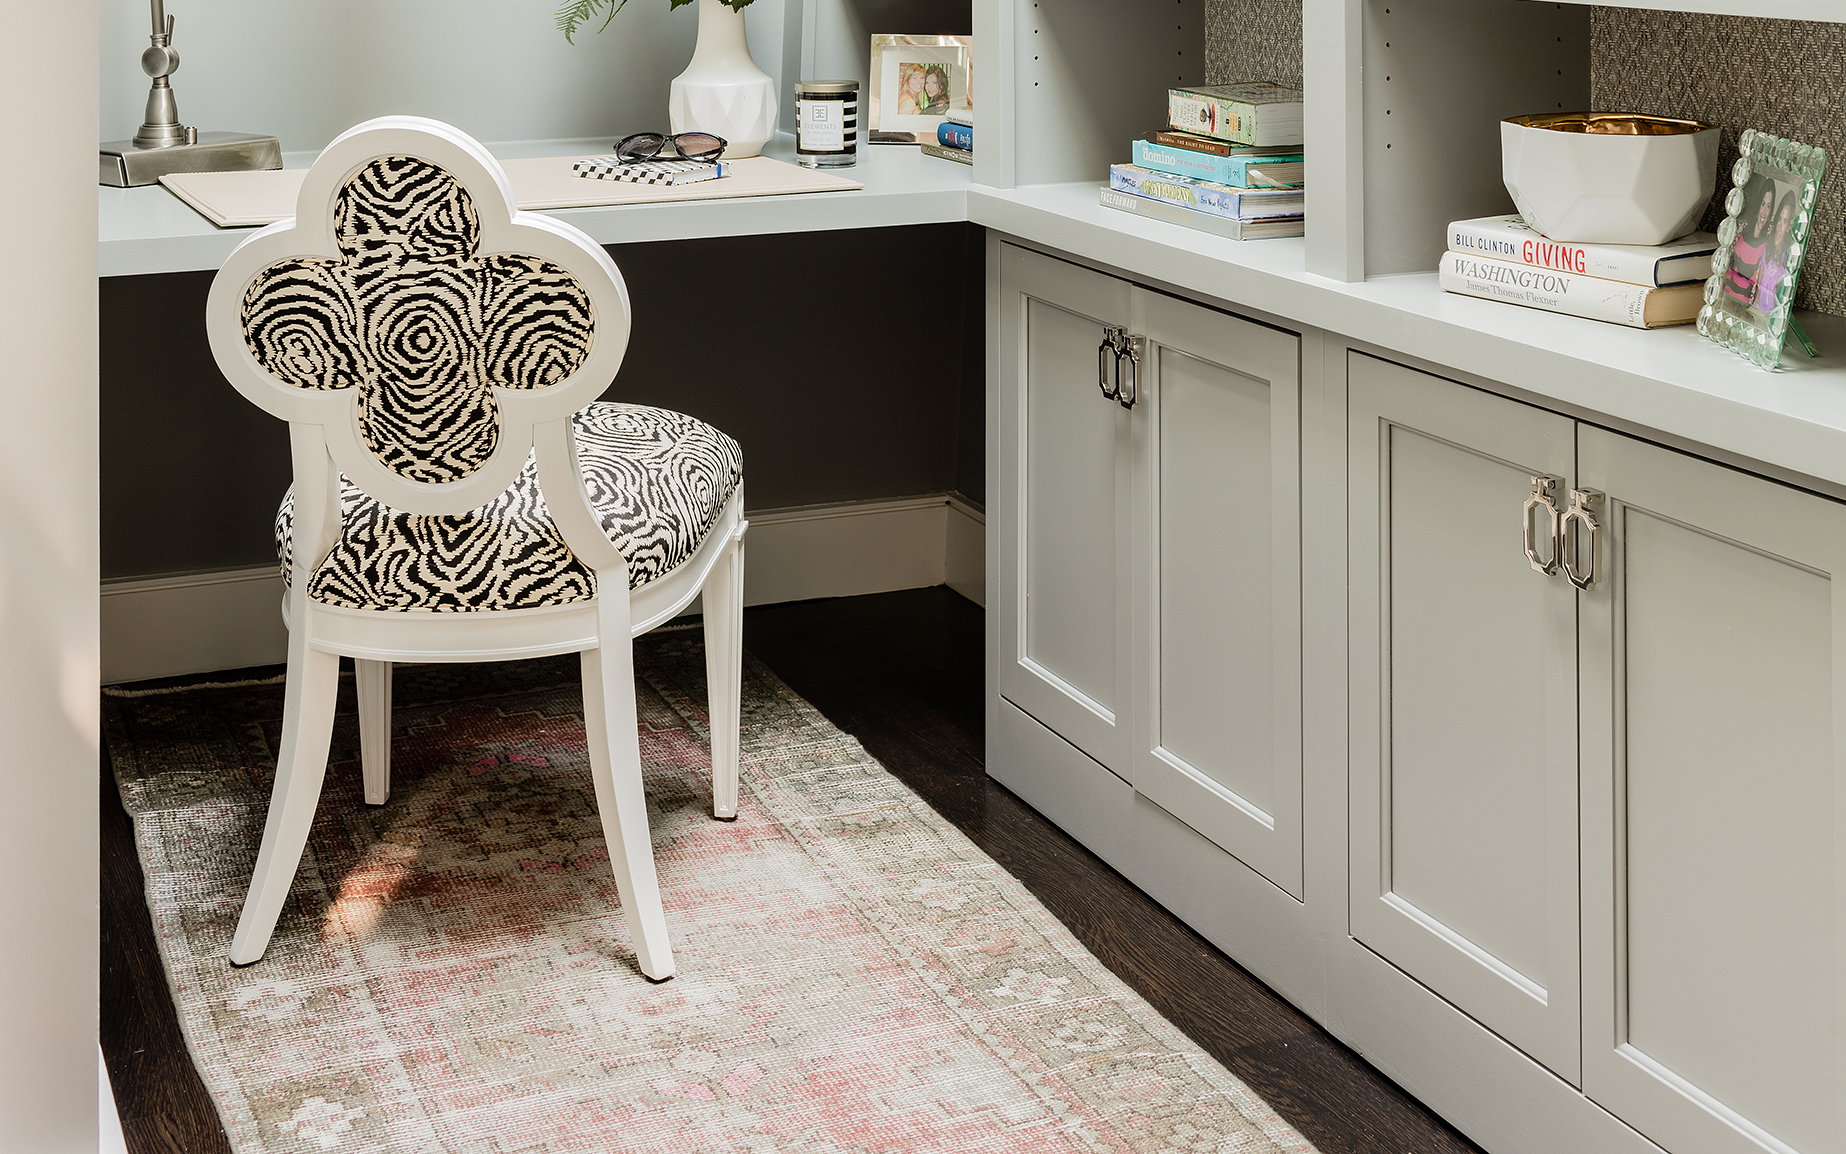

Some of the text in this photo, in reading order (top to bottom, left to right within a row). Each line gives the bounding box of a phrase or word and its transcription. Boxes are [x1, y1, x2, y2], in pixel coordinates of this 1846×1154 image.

[804, 122, 837, 130] ELEMENTS
[1185, 140, 1198, 148] RIGHT
[1142, 148, 1176, 166] domino
[1142, 201, 1195, 225] KEVYN AUCOIN
[1456, 233, 1587, 275] BILL CLINTON GIVING
[1454, 258, 1571, 295] WASHINGTON
[1466, 280, 1558, 307] James Thomas Flexner
[1635, 290, 1644, 316] Brown
